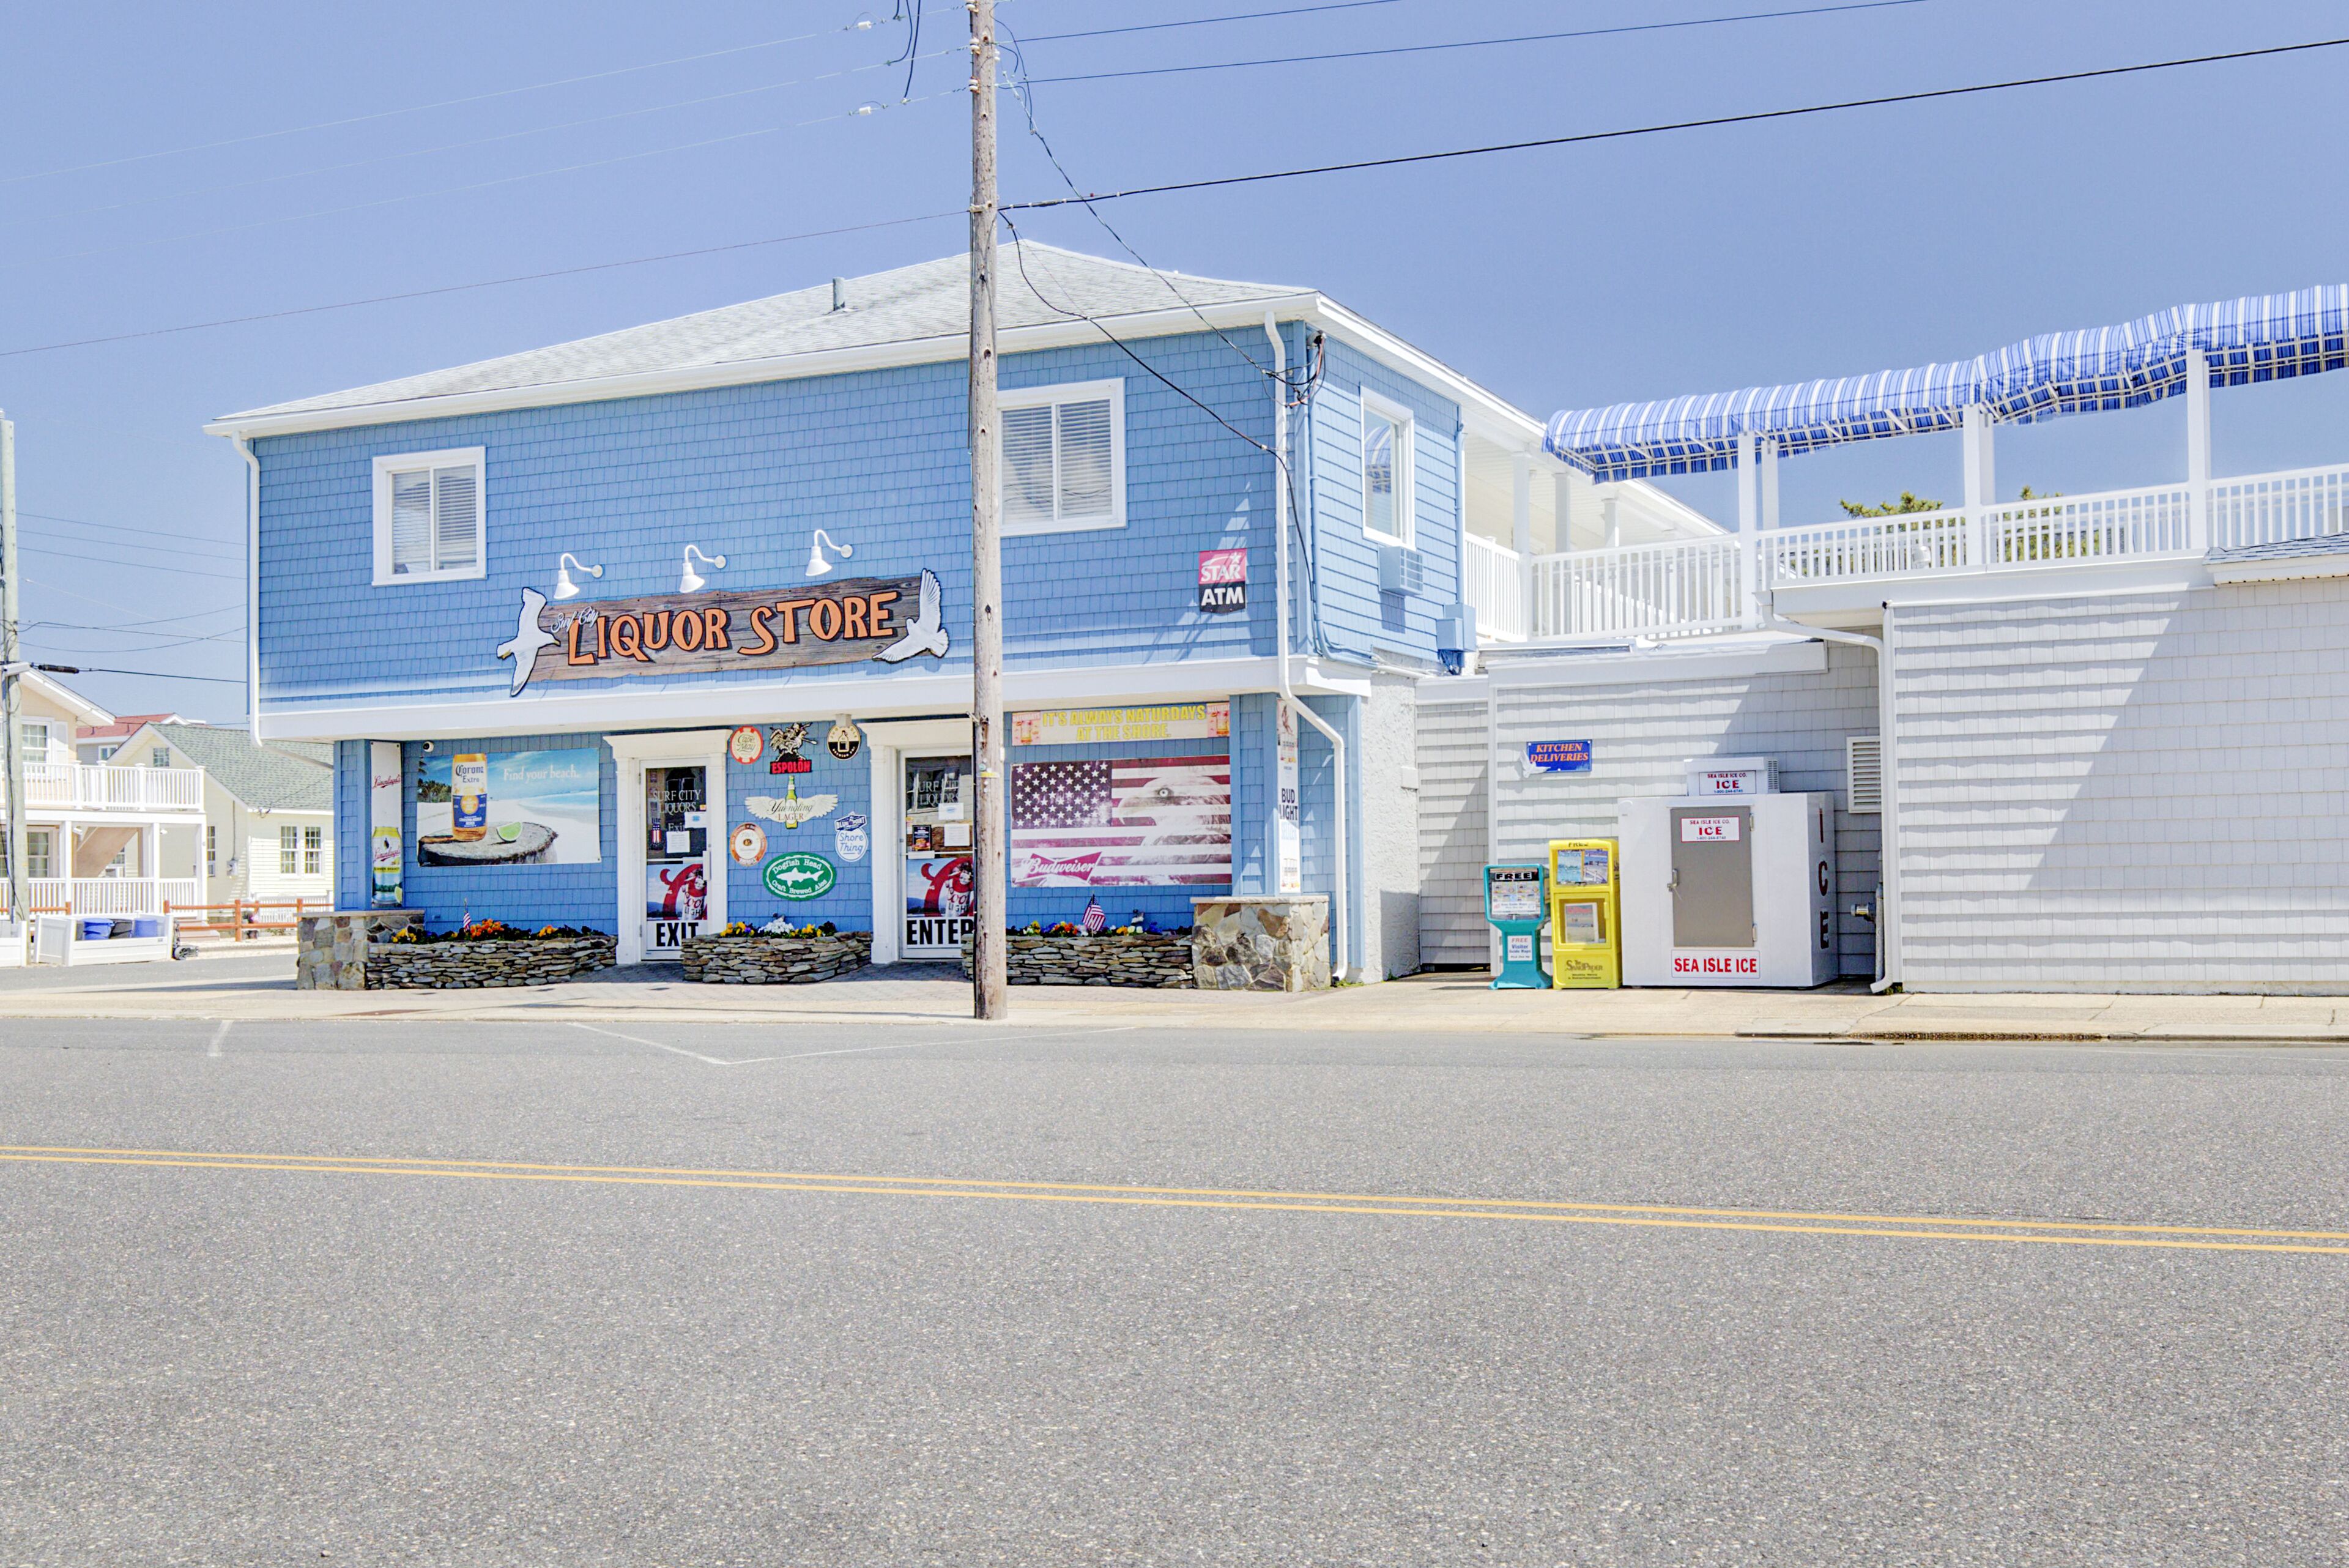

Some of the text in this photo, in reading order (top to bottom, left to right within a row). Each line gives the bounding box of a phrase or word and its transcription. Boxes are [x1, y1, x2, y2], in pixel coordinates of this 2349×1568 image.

[1201, 564, 1242, 581] STAR
[1201, 587, 1244, 606] ATM
[551, 606, 599, 633] Surf City
[568, 591, 900, 666] LIQUOR STORE
[1043, 712, 1067, 726] IT'S
[1069, 707, 1123, 726] ALWAYS
[1126, 705, 1206, 723] NATURDAYS
[1077, 727, 1092, 741] AT
[1095, 724, 1119, 740] THE
[1536, 743, 1583, 752] KITCHEN
[1530, 752, 1589, 763] DELIVERIES
[456, 764, 484, 777] Corona
[503, 764, 579, 783] Find your beach.
[1716, 779, 1740, 789] ICE
[653, 789, 701, 802] SURF CITY
[1282, 788, 1296, 803] BUD
[661, 802, 696, 816] LIQUORS
[1279, 804, 1298, 820] LIGHT
[839, 833, 864, 842] Shore
[1699, 826, 1723, 836] ICE
[841, 842, 864, 855] Thing
[773, 858, 800, 874] Dogfish
[804, 859, 822, 870] Head
[1022, 857, 1097, 874] Budweiser
[656, 923, 699, 947] EXIT
[1674, 957, 1757, 973] SEA ISLE ICE
